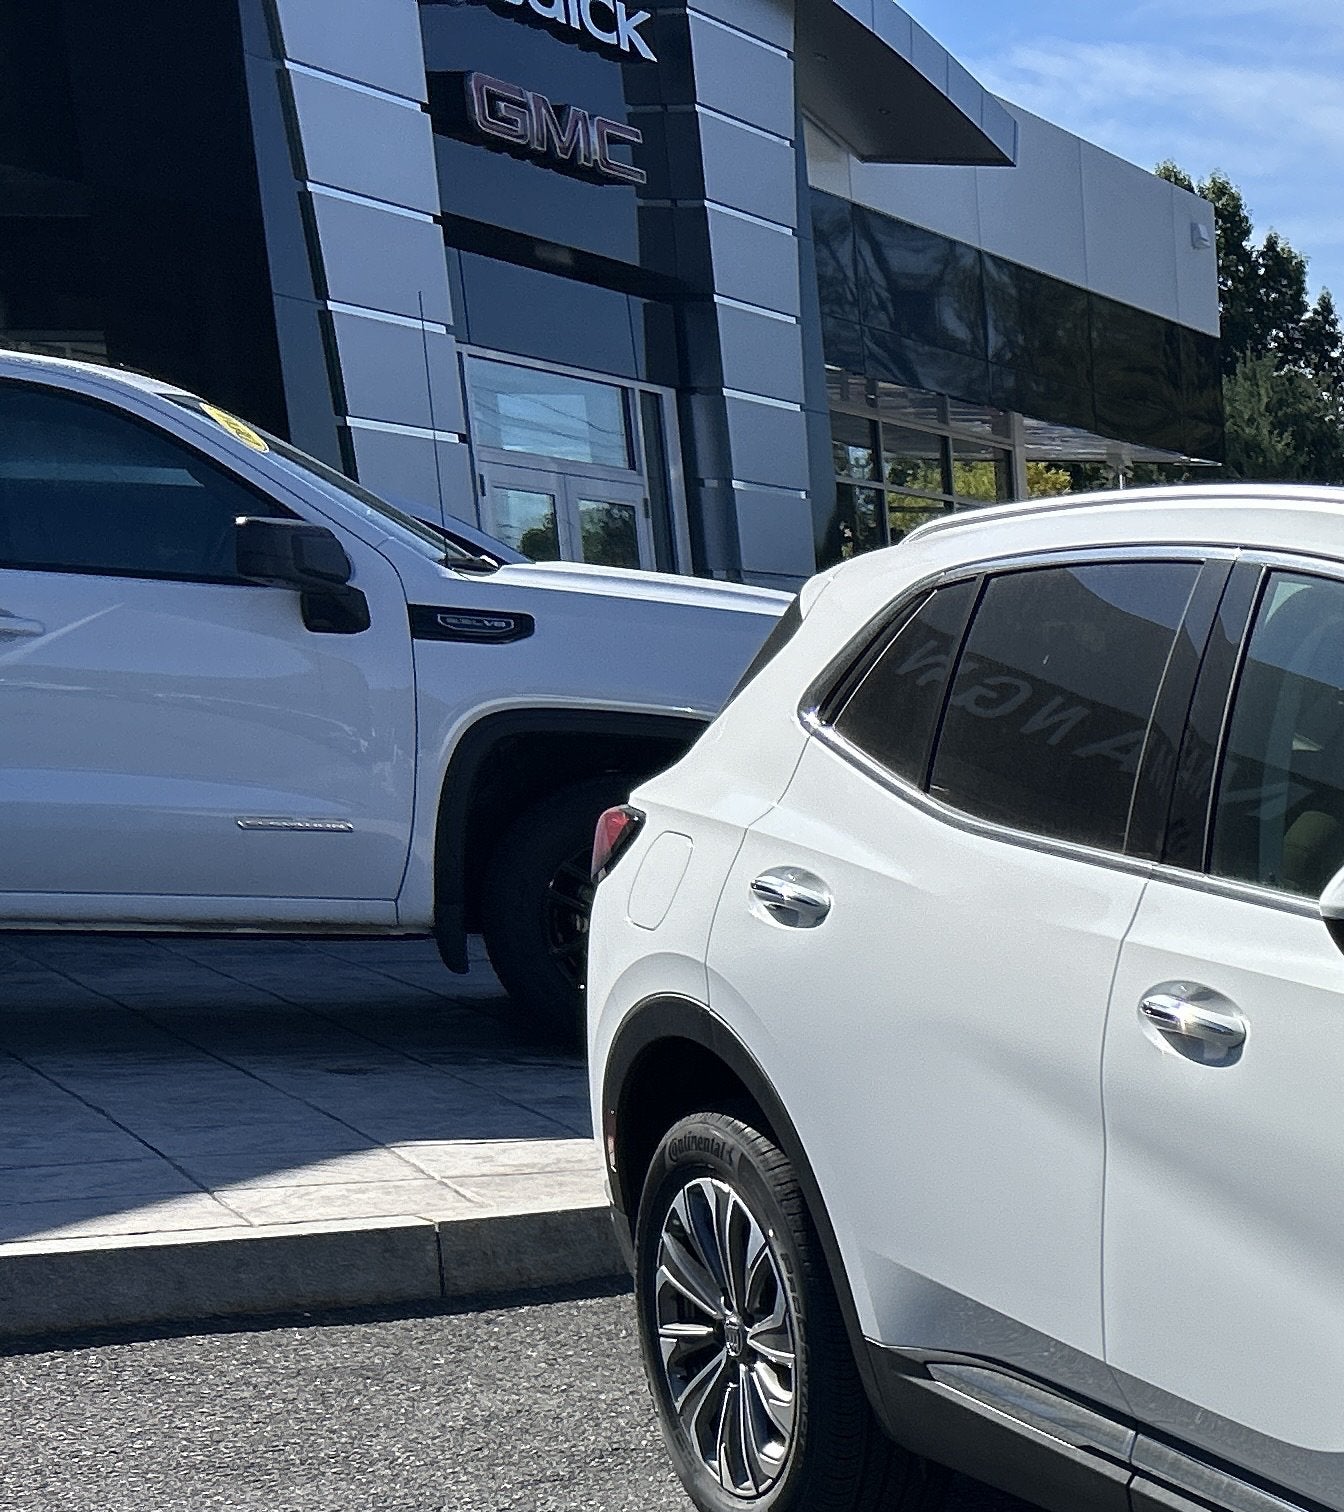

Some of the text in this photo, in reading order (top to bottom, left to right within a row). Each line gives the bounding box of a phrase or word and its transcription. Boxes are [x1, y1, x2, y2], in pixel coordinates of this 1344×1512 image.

[505, 0, 658, 62] uick
[470, 72, 647, 184] GMC
[668, 1130, 727, 1162] Continental
